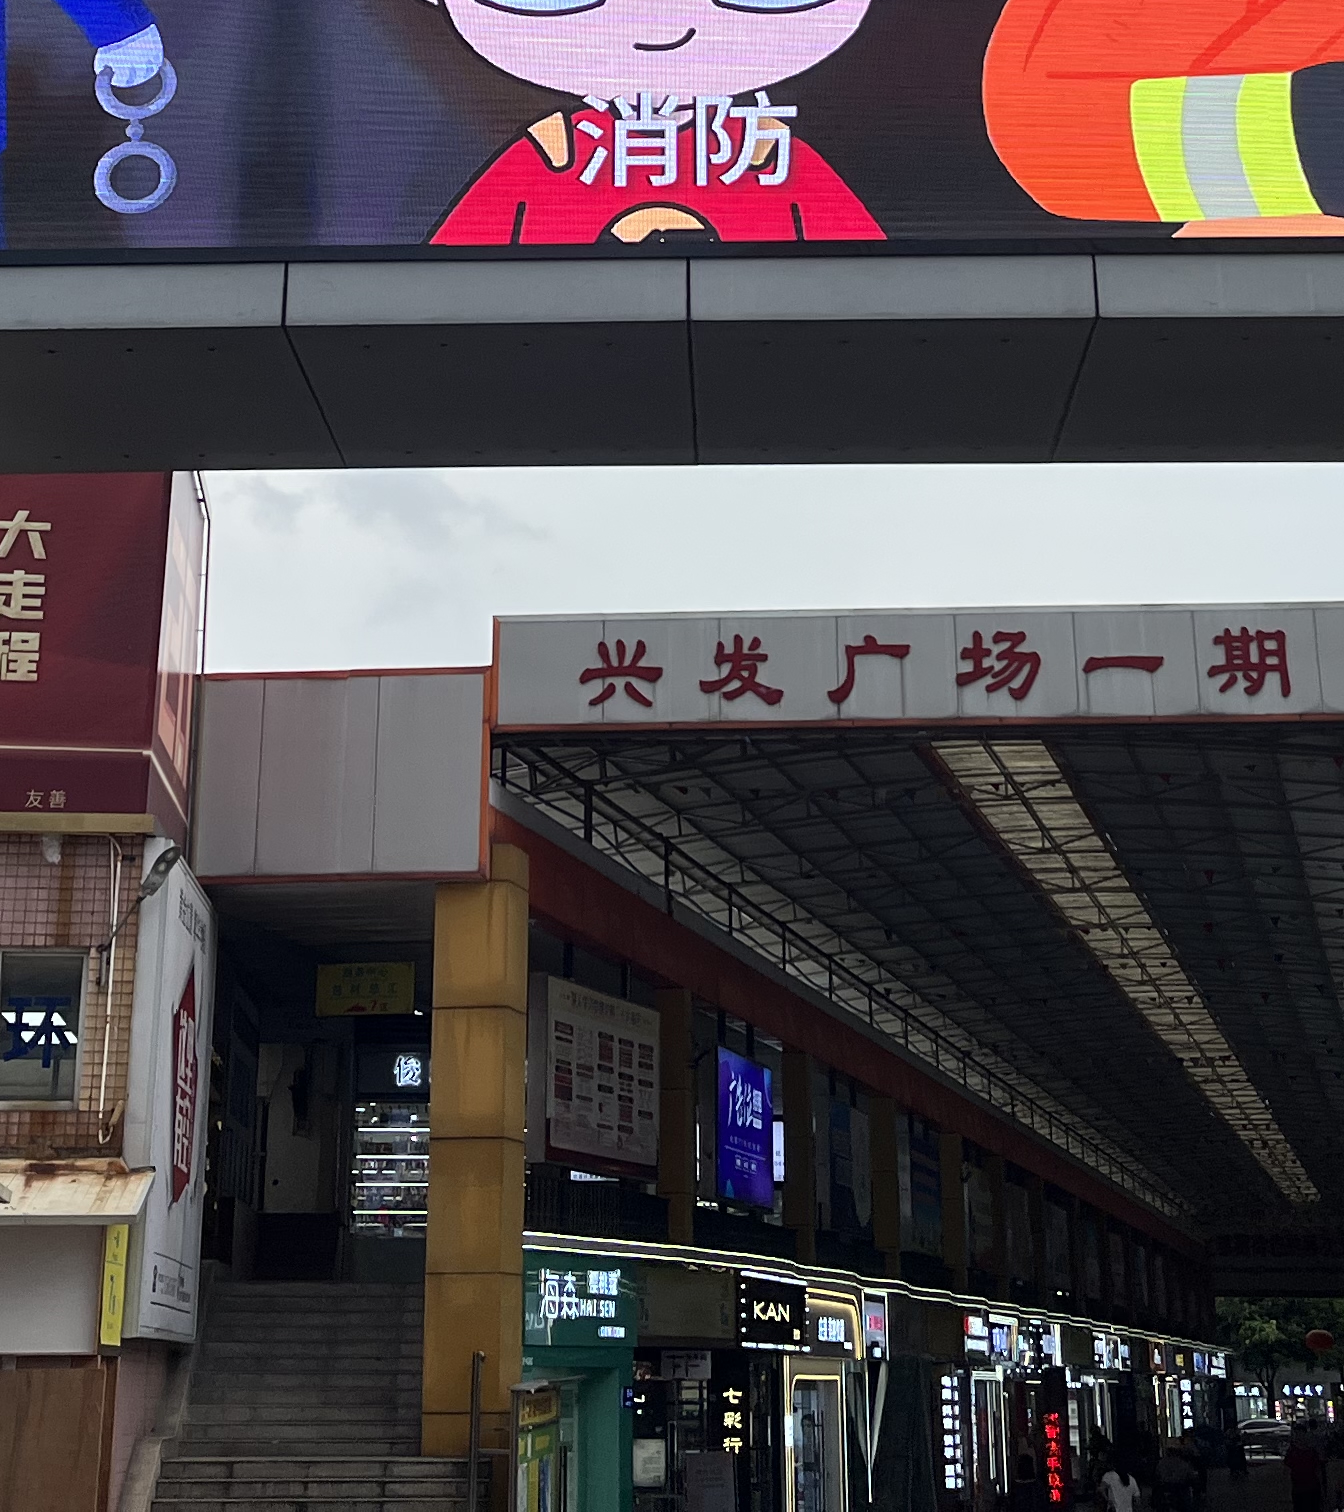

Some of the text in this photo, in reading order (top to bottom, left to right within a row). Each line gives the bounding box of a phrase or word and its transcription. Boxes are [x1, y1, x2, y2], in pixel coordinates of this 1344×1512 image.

[573, 90, 798, 187] 消防
[578, 627, 1291, 706] 兴发广场一期
[25, 789, 67, 809] 友善
[1, 997, 79, 1070] 环
[538, 1268, 579, 1320] 海森
[753, 1300, 791, 1323] KAN
[722, 1387, 744, 1455] 七彩行
